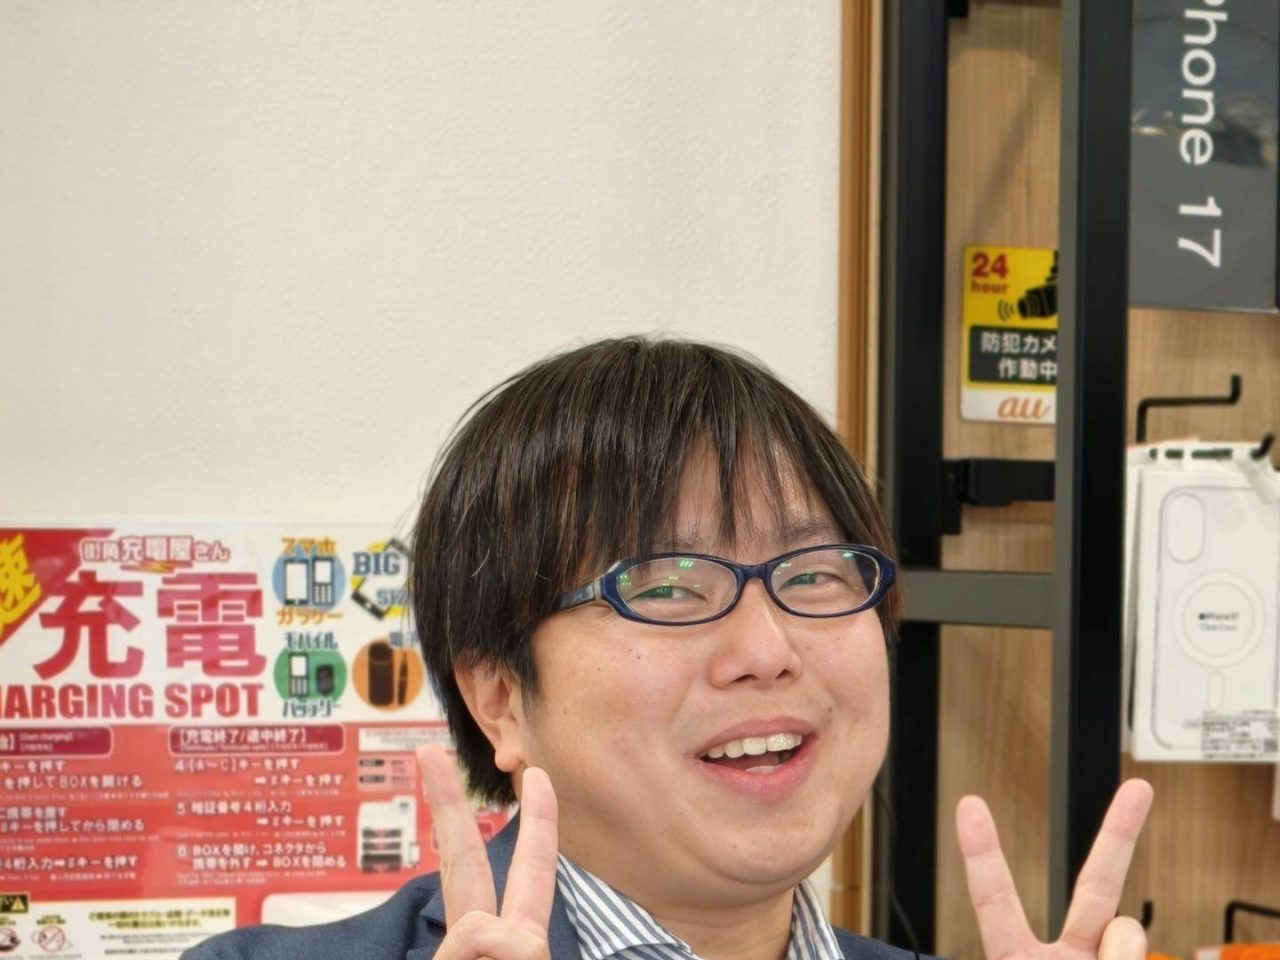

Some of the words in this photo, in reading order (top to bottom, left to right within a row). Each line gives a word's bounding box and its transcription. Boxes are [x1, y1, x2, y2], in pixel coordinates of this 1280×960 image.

[1177, 196, 1222, 268] 17
[972, 252, 1008, 278] 24
[971, 281, 1008, 294] hour
[980, 332, 1057, 353] 防犯カメ
[997, 359, 1058, 380] 作動中
[997, 397, 1050, 420] au
[281, 536, 337, 554] スマホ
[352, 553, 400, 575] BIG
[33, 570, 267, 680] 充電
[277, 608, 343, 625] ガラケー
[285, 632, 338, 648] モバイル
[0, 684, 153, 719] ARGING
[165, 684, 264, 718] SPOT
[283, 700, 342, 718] バッテリー
